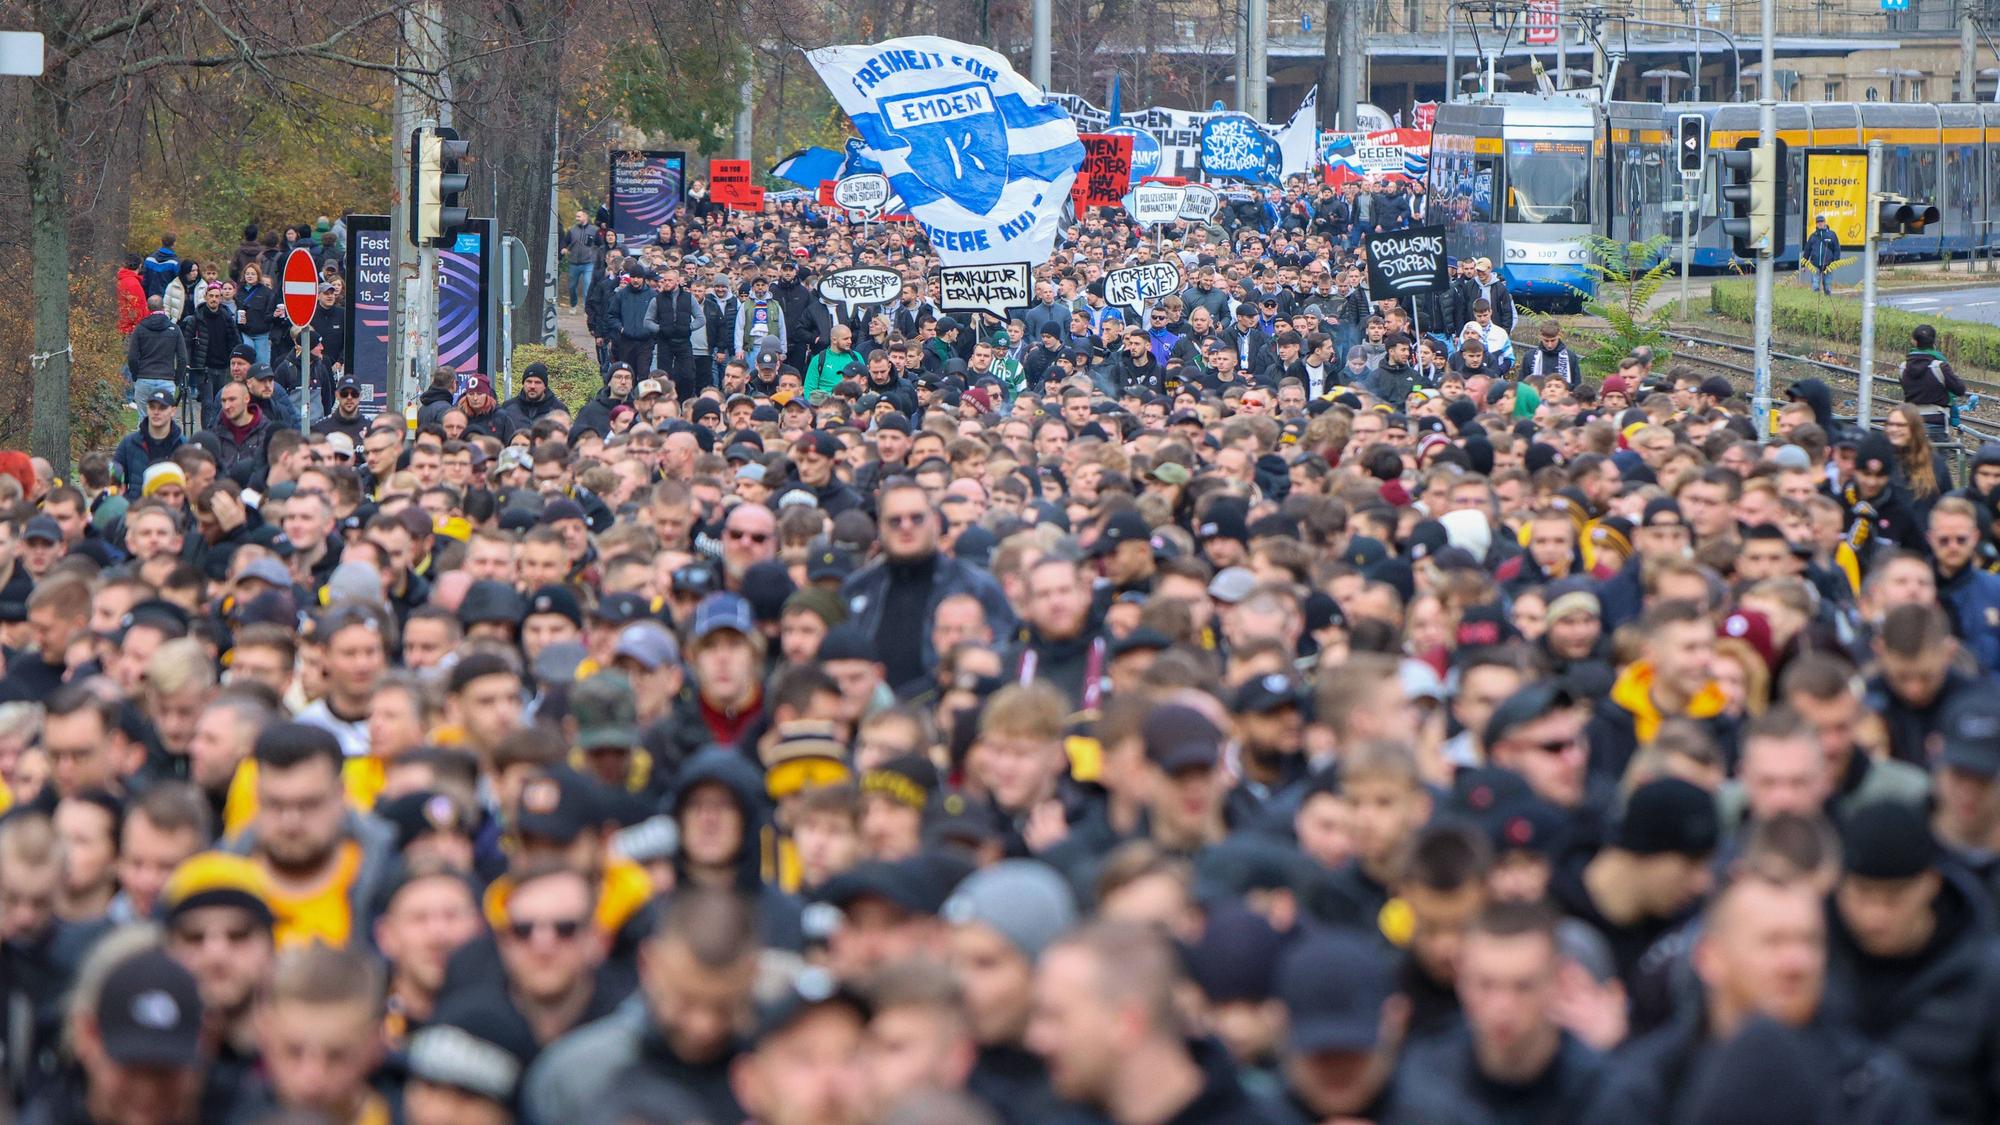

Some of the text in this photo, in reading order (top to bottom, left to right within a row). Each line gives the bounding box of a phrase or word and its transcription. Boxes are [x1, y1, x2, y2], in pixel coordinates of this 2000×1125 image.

[852, 49, 944, 98] FREIHEIT
[902, 91, 982, 122] EMDEN
[1358, 147, 1403, 159] GEGEN
[843, 182, 853, 192] DIE
[1813, 177, 1860, 186] Leipziger.
[1813, 188, 1835, 196] Eure
[1813, 198, 1853, 208] Energie.
[1371, 236, 1443, 260] POPULISMUS
[1378, 253, 1437, 277] STOPPEN
